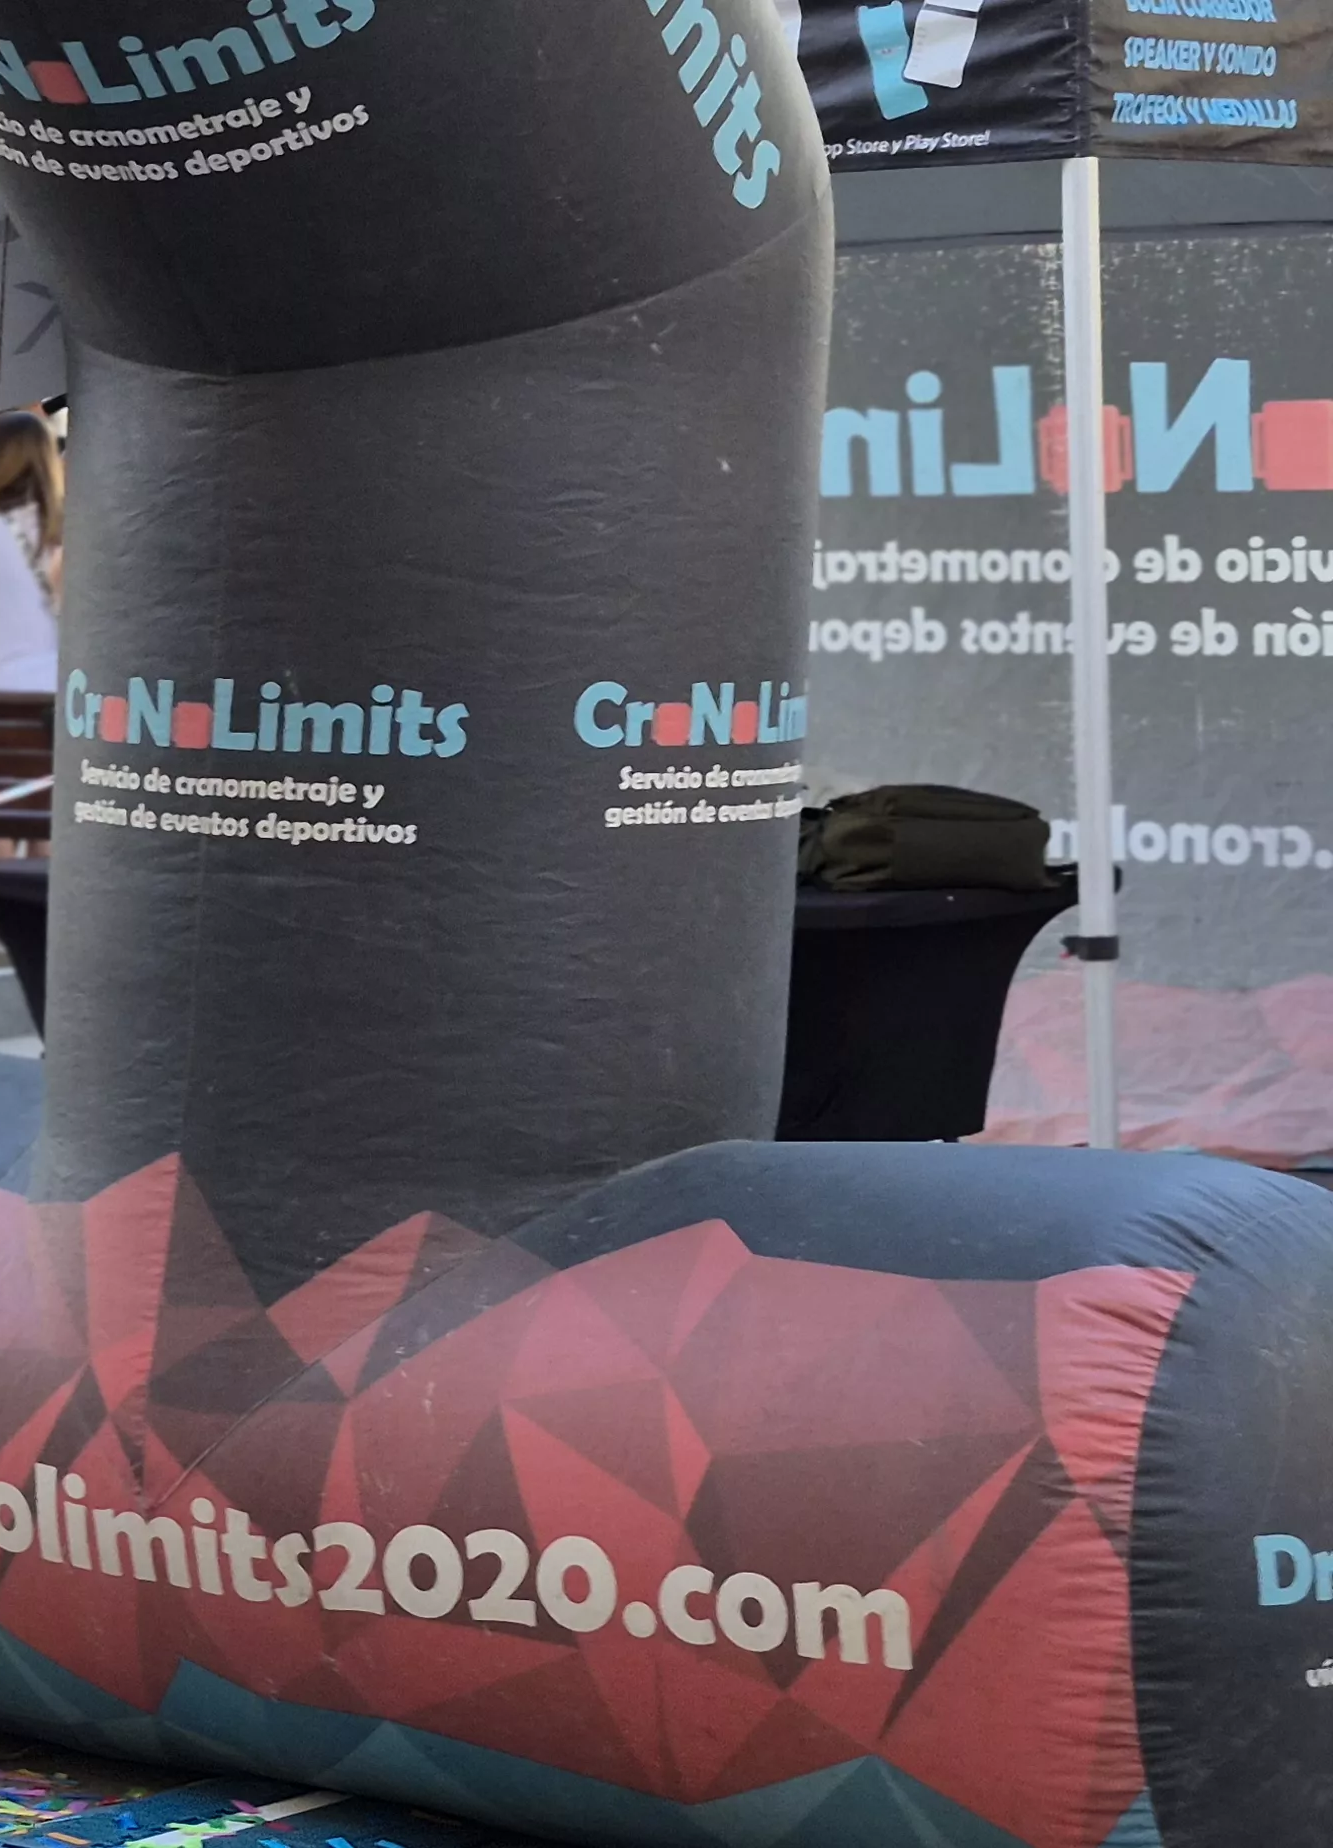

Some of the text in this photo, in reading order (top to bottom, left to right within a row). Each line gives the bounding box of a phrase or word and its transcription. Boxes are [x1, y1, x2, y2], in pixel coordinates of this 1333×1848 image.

[1124, 36, 1276, 77] SPEAKER Y SONIDO
[29, 119, 65, 145] de
[284, 85, 312, 113] y
[1111, 92, 1298, 129] TROFEOS Y MEDALLAS
[31, 150, 66, 176] de
[68, 157, 178, 182] eventos
[183, 104, 369, 177] deportivos
[847, 137, 888, 155] Store
[889, 140, 901, 155] y
[905, 134, 941, 153] Play
[942, 129, 991, 148] Store!
[80, 758, 140, 790] Servicio
[143, 767, 171, 794] de
[361, 783, 385, 809] y
[618, 765, 703, 790] Servicio
[705, 764, 729, 788] de
[130, 803, 157, 830] de
[160, 811, 249, 838] eventos
[255, 812, 418, 846] deportivos
[604, 800, 687, 828] gestión
[690, 799, 717, 824] de
